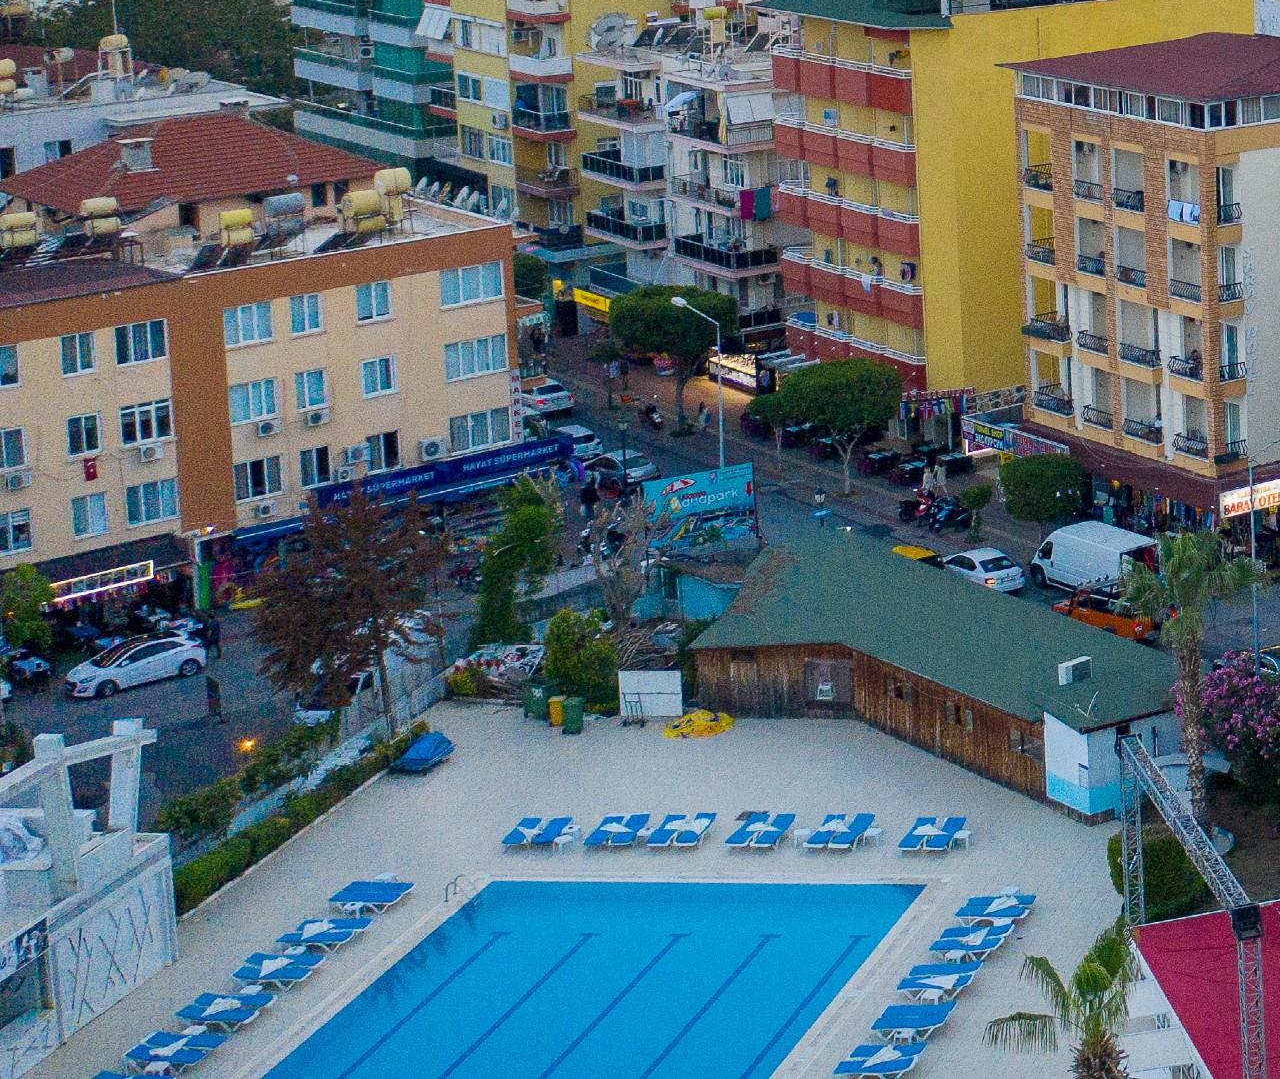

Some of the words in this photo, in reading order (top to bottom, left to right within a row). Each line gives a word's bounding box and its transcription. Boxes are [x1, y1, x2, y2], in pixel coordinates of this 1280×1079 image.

[511, 374, 522, 440] MARKET
[462, 458, 493, 473] HAYAT
[494, 443, 560, 466] SÜPERMARKET
